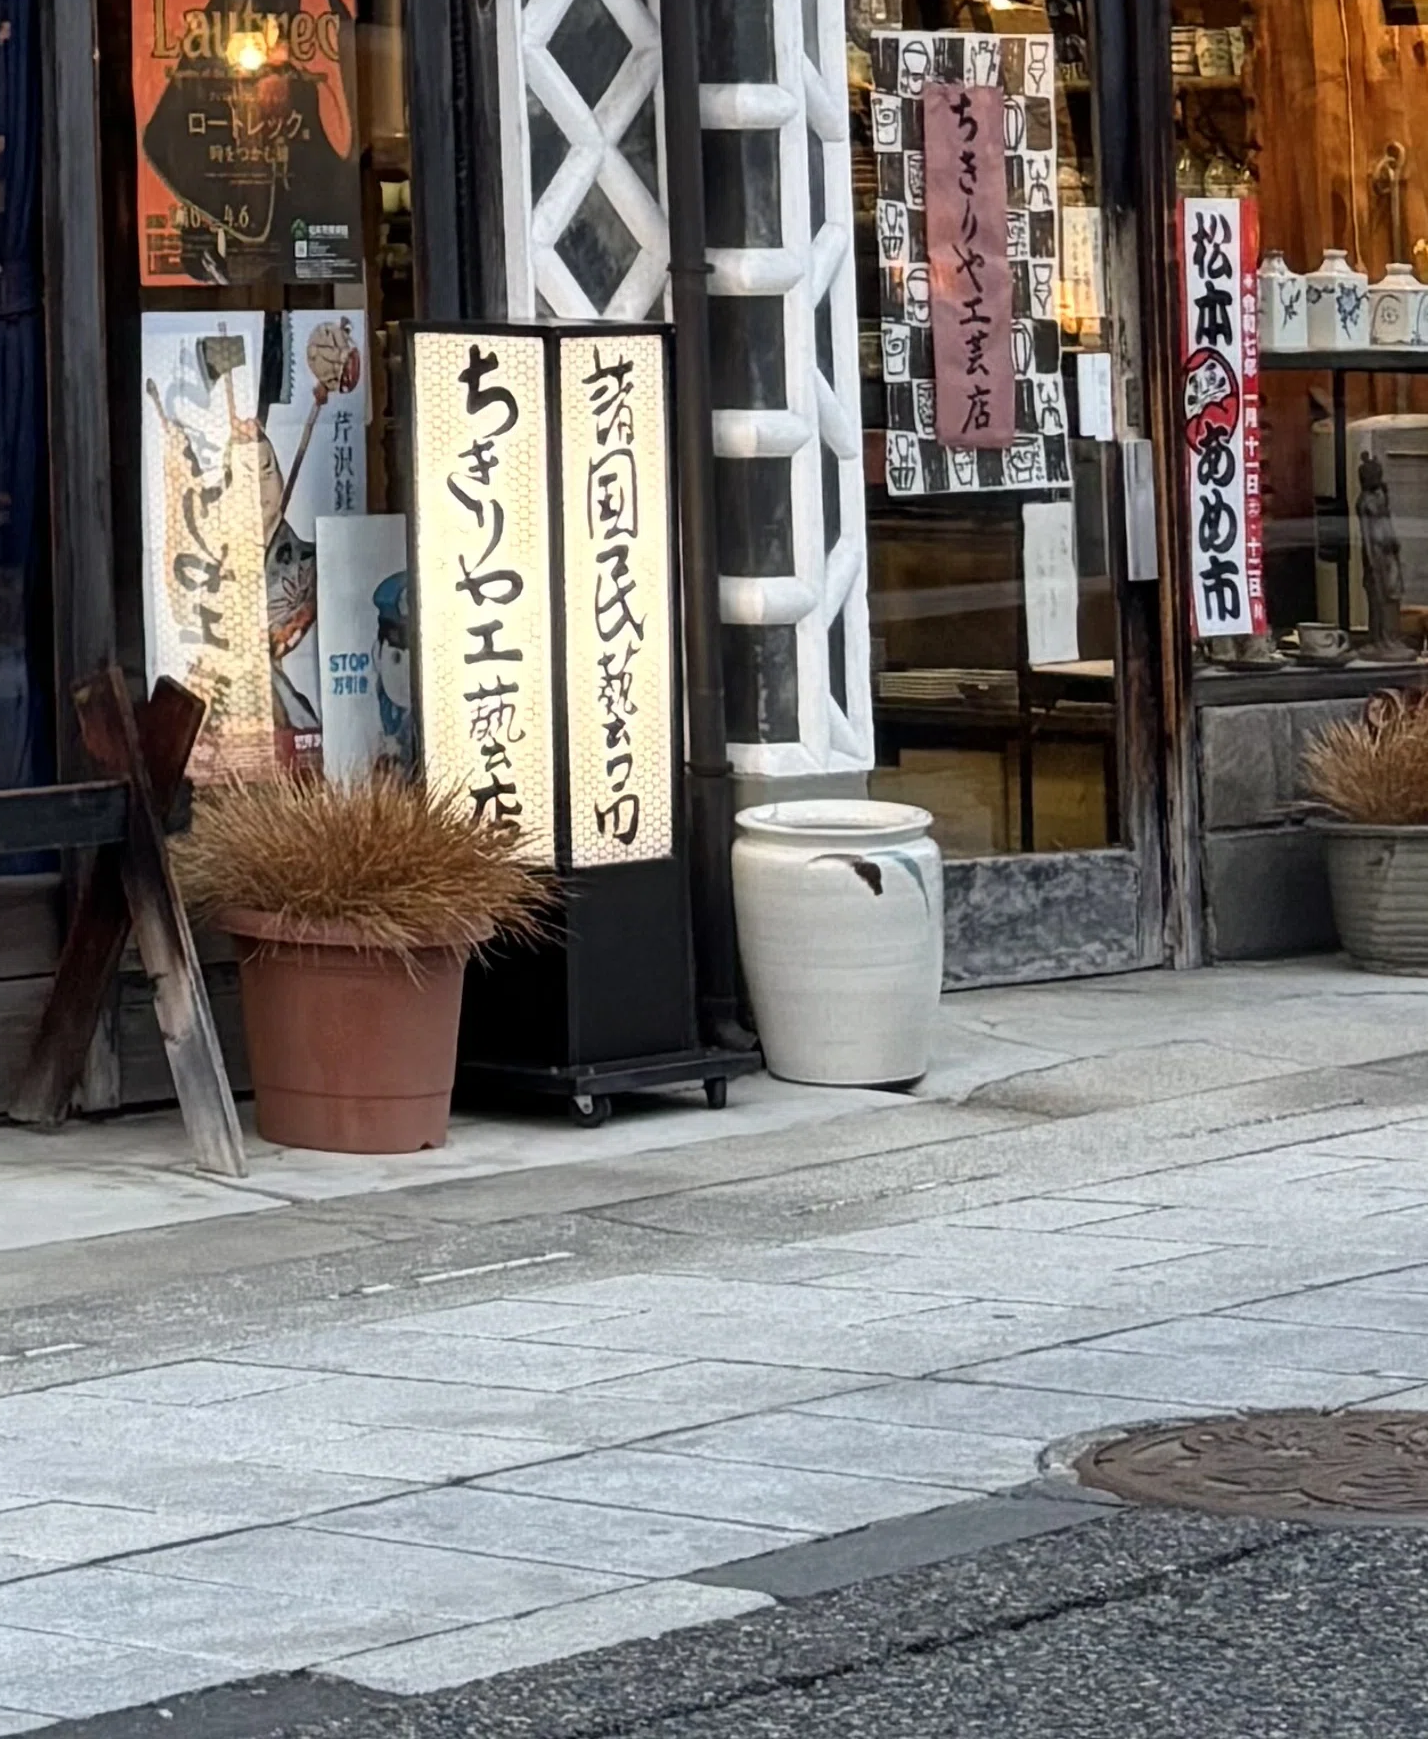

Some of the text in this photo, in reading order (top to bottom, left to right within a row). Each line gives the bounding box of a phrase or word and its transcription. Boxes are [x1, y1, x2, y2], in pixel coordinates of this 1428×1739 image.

[949, 92, 993, 434] ちきりや工芸店
[329, 653, 370, 673] STOP
